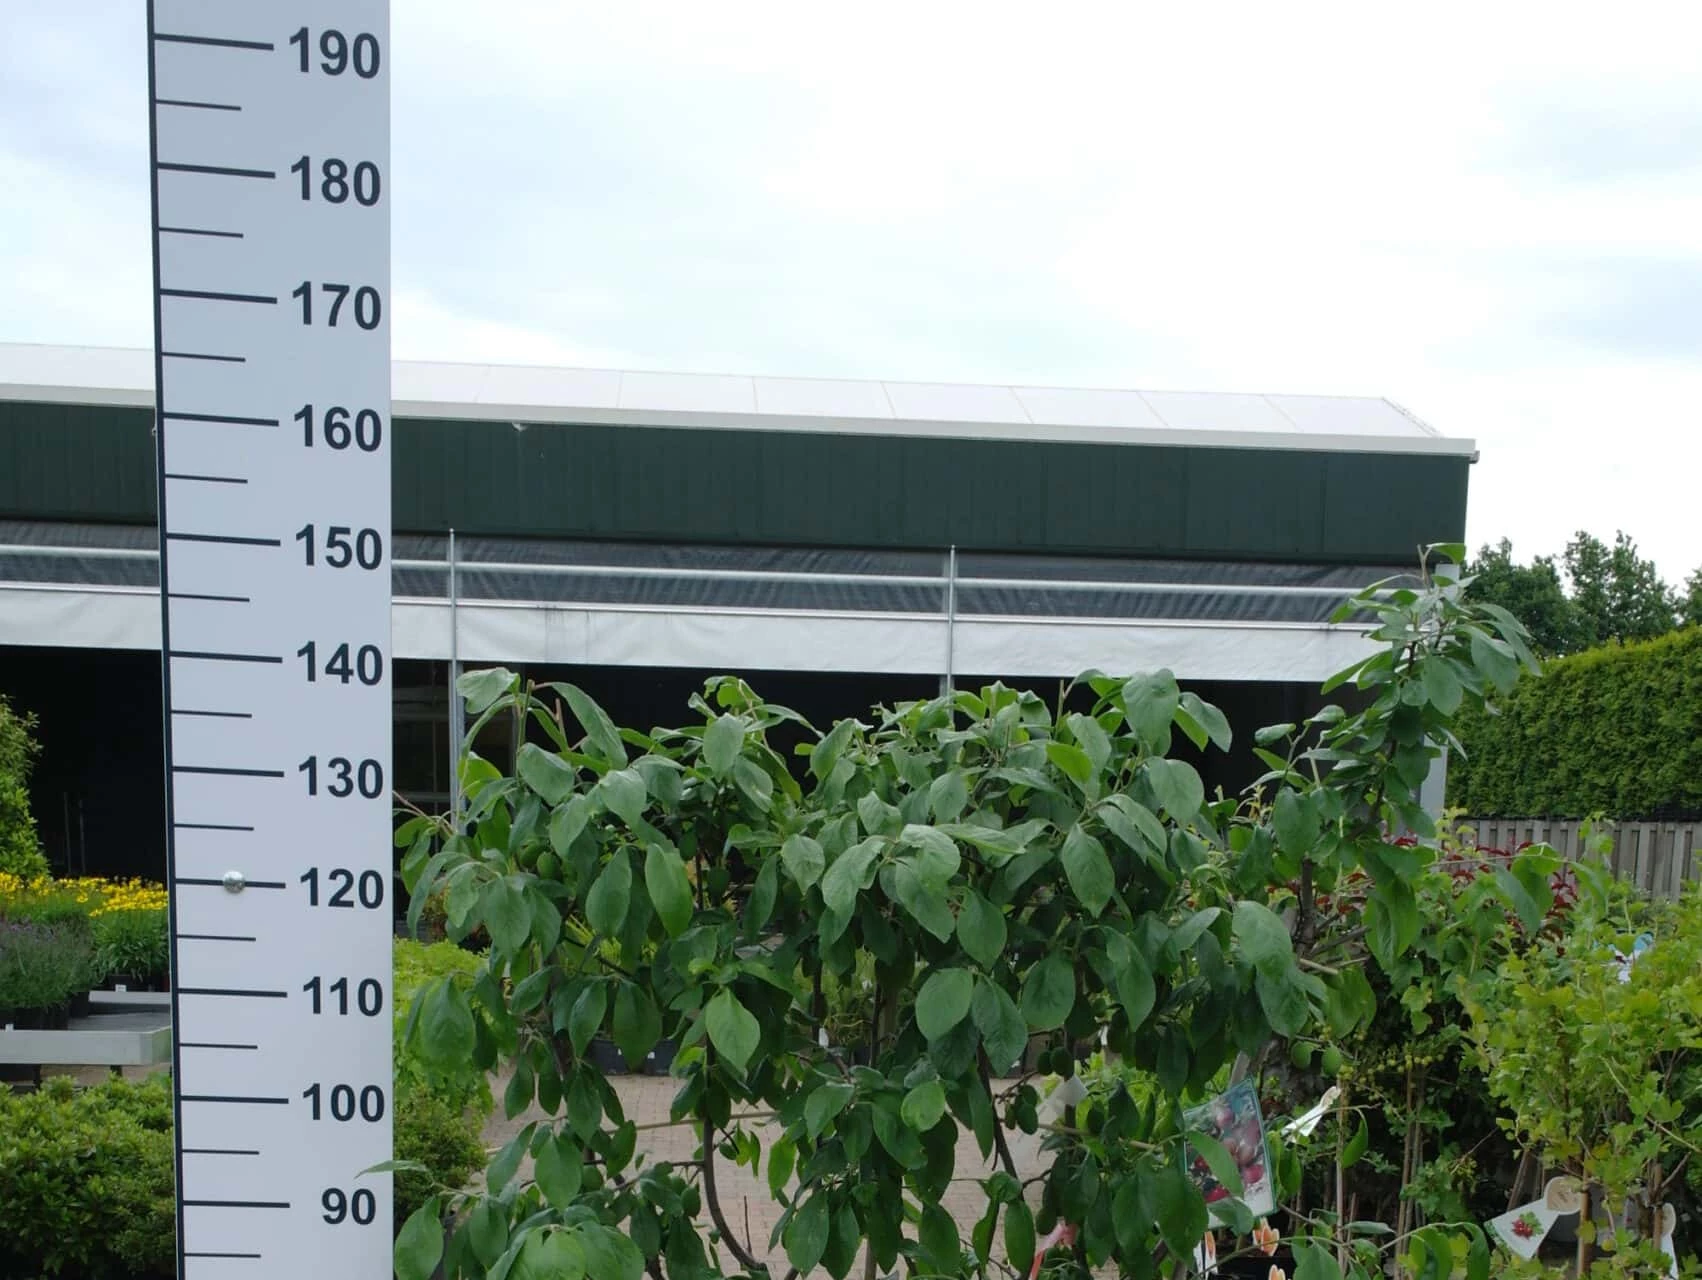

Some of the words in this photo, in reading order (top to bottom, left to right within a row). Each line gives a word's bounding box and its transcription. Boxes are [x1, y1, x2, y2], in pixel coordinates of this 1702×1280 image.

[290, 27, 380, 78] 190
[291, 156, 380, 206] 180
[293, 281, 381, 330] 170
[295, 405, 381, 451] 160
[296, 524, 382, 570] 150
[298, 641, 382, 685] 140
[299, 756, 383, 799] 130
[301, 868, 383, 909] 120
[304, 976, 382, 1016] 110
[303, 1083, 383, 1122] 100
[322, 1188, 376, 1225] 90
